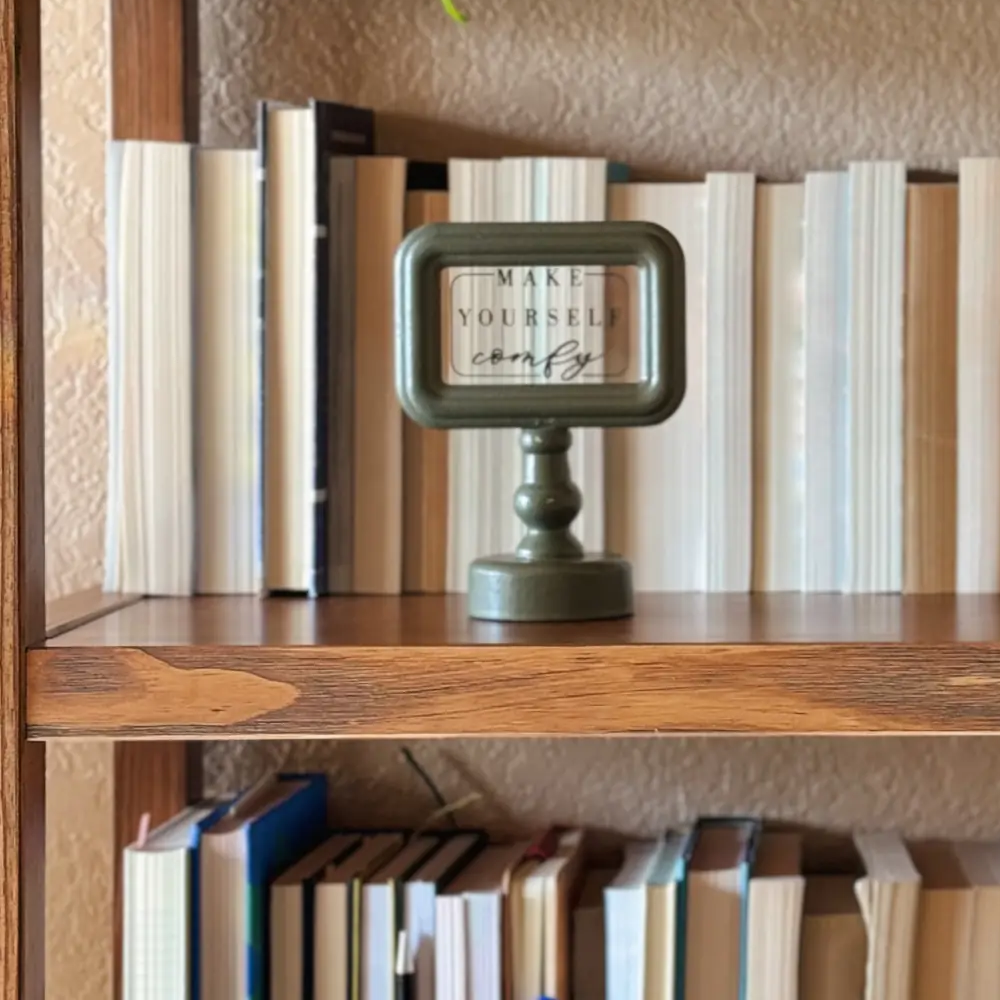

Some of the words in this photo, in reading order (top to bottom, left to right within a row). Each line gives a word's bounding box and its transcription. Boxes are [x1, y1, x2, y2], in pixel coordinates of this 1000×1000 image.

[497, 268, 583, 287] MAKE
[457, 307, 622, 327] YOURSELF
[471, 339, 602, 381] comfy
